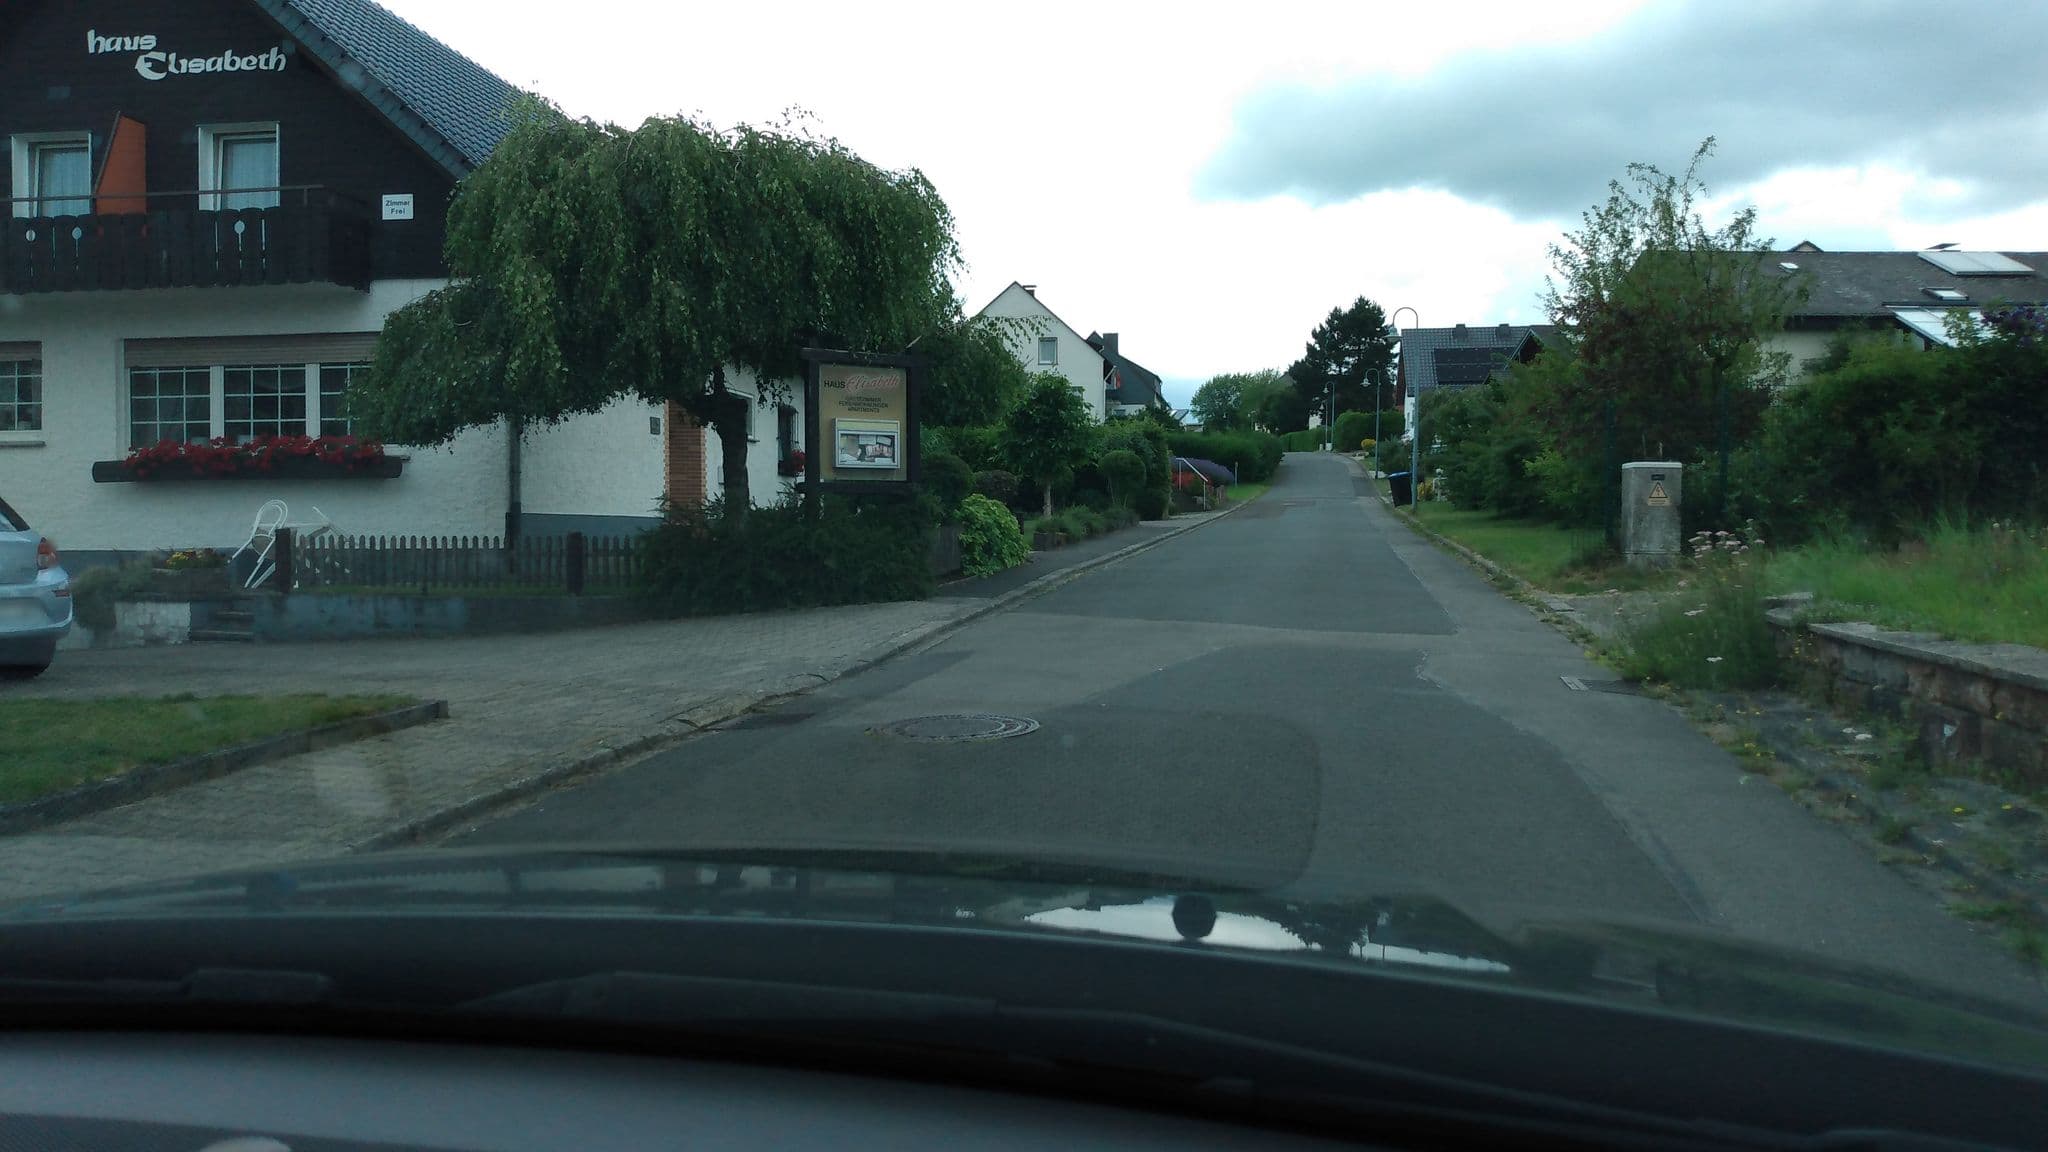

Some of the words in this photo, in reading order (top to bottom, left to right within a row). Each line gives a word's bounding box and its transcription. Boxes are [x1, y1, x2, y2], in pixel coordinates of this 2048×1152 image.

[87, 29, 157, 54] haus
[134, 47, 287, 81] Elisabeth
[823, 380, 846, 389] HAUS
